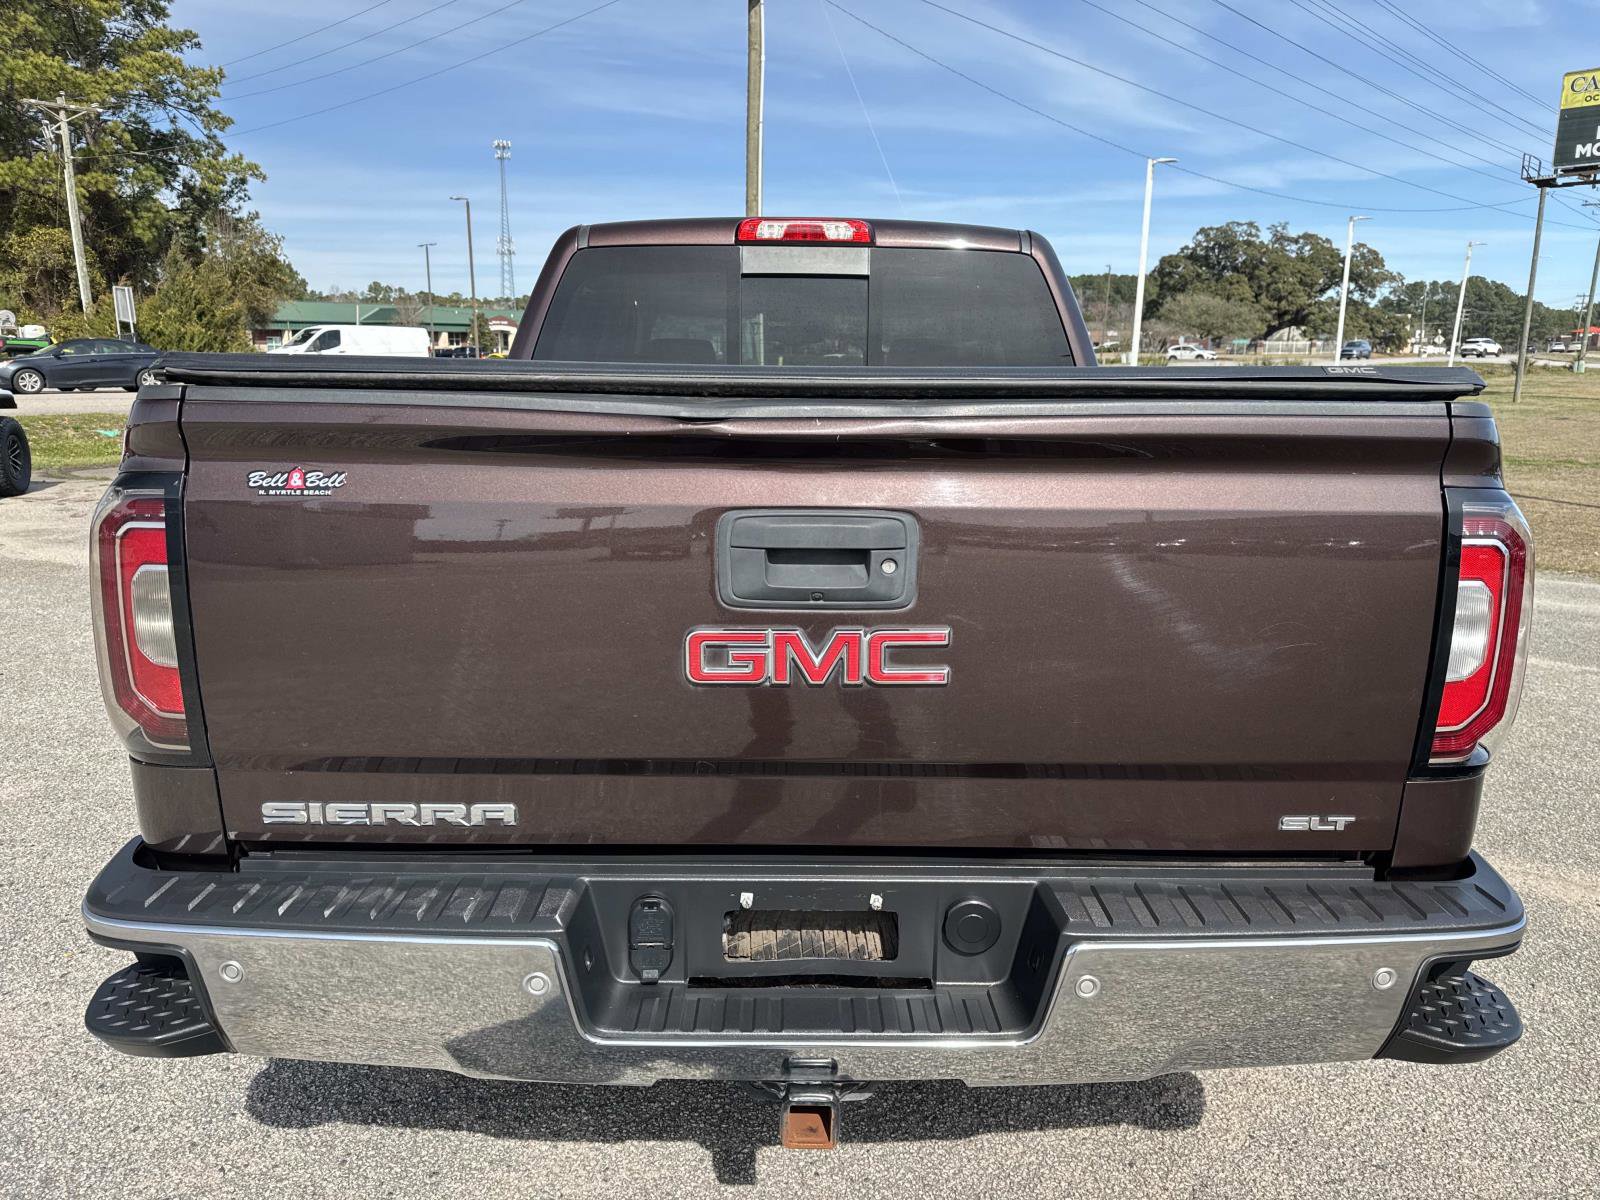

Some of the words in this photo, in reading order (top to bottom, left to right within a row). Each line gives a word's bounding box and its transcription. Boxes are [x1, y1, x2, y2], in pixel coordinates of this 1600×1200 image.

[248, 471, 288, 487] Bell
[290, 472, 302, 486] &
[305, 471, 346, 487] Bell
[684, 627, 951, 686] GMC
[261, 802, 518, 827] SIERRA
[1279, 815, 1356, 831] SLT
